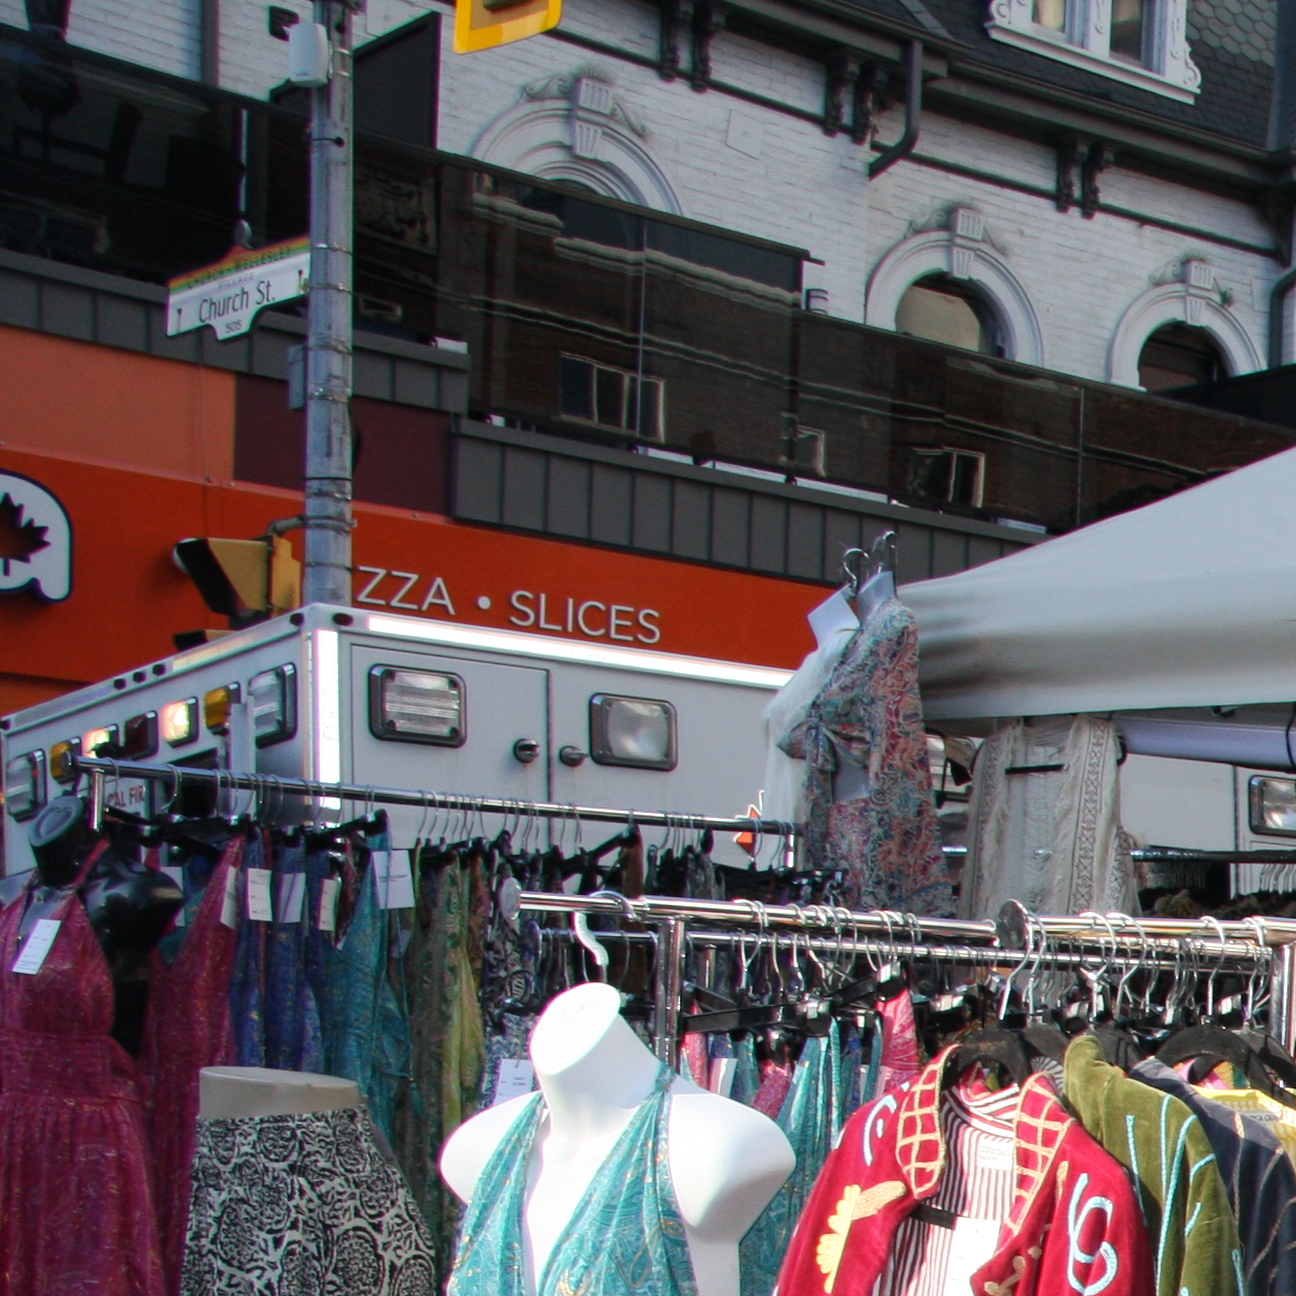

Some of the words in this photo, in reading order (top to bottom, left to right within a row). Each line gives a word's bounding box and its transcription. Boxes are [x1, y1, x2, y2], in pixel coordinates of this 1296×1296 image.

[198, 287, 249, 323] Church
[255, 280, 276, 304] St.
[356, 565, 456, 616] ZZA
[510, 589, 662, 645] SLICES
